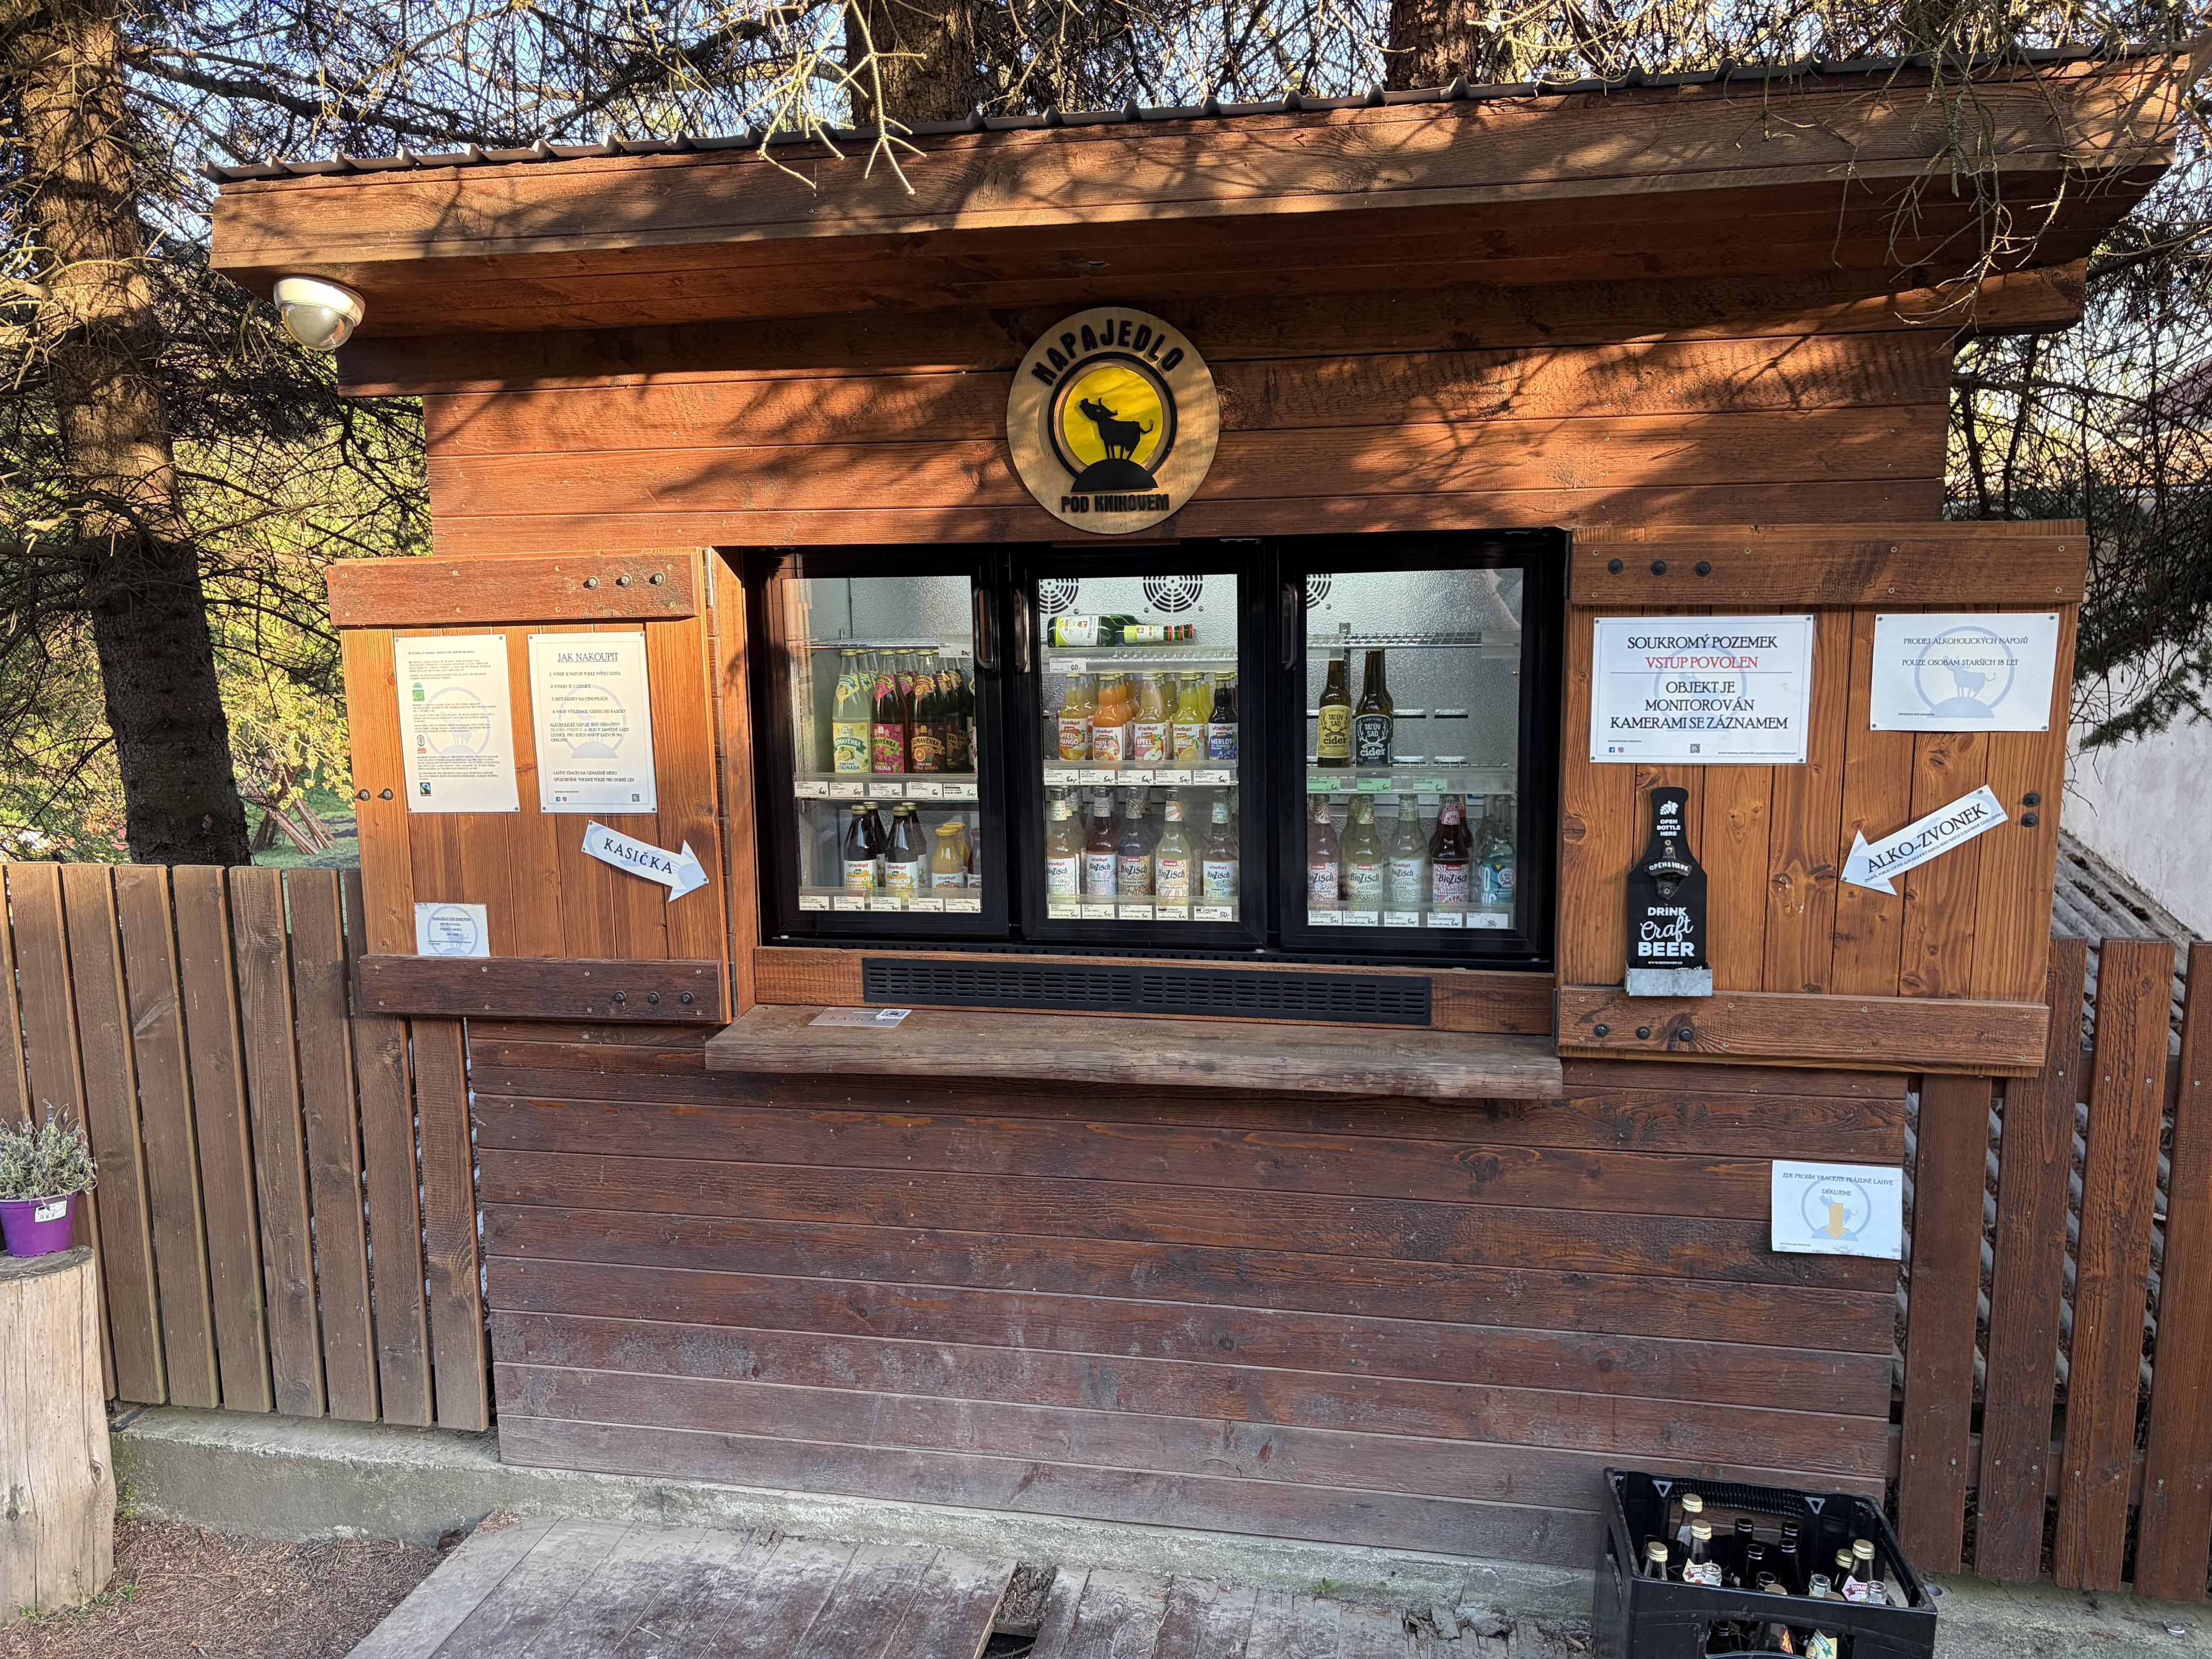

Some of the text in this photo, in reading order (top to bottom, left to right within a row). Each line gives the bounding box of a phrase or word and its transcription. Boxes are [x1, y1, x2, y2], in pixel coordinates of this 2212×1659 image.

[1031, 320, 1184, 386] NAPAJEDLO
[1062, 494, 1170, 512] POD KNIHOVEM
[1628, 634, 1777, 649] SOUKROMÝ POZEMEK
[1932, 636, 1997, 645] ALKOHOLICKÝCH
[1999, 636, 2028, 644] NÁPOJŮ
[557, 652, 618, 662] JAK NAKOUPIT
[1645, 656, 1758, 669] VSTUP POVOLEN
[1962, 658, 1995, 666] STARŠÍCH
[1665, 682, 1735, 693] OBJEKT JE
[1645, 697, 1755, 711] MONITOROVÁN
[1610, 714, 1788, 729] KAMERAMI SE ZÁZNAMEM
[1323, 736, 1347, 744] cider
[1360, 747, 1385, 756] cider
[1869, 803, 1988, 873] ALKO-ZVONEK
[604, 838, 673, 874] KASIČKA
[1089, 863, 1110, 871] BioZisch
[1121, 865, 1147, 875] BioZisch
[1649, 861, 1688, 871] OPEN HERE
[1158, 868, 1185, 879] BioZisch
[1207, 871, 1230, 880] BioZisch
[1391, 868, 1413, 877] BioZisch
[1351, 873, 1379, 884] BioZisch
[1438, 874, 1467, 885] BioZisch
[1648, 907, 1687, 916] DRINK
[1640, 915, 1694, 942] Craft
[1638, 942, 1695, 956] BEER
